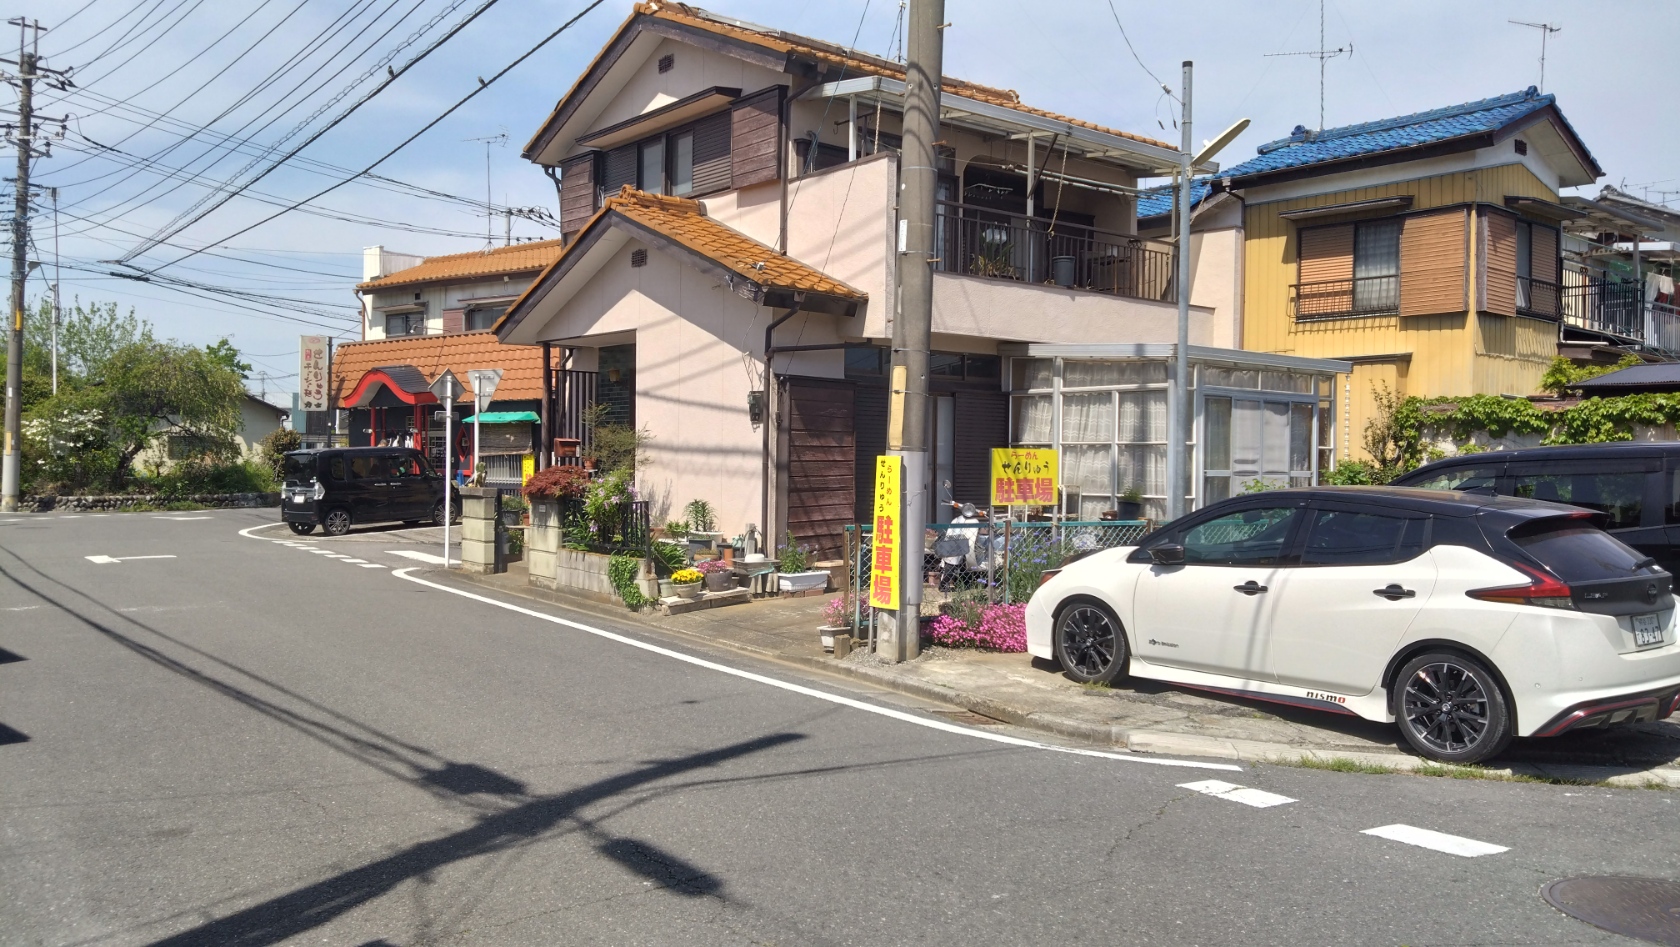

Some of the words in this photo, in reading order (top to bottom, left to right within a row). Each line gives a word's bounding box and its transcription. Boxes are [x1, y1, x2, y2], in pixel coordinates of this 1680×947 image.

[1001, 461, 1050, 475] せんりゅう
[1011, 450, 1039, 460] らーめん
[878, 459, 886, 513] せんりゅう
[885, 465, 893, 507] らーめん
[995, 477, 1054, 503] 駐車場
[872, 514, 894, 605] 駐車場
[1306, 691, 1346, 704] nismo
